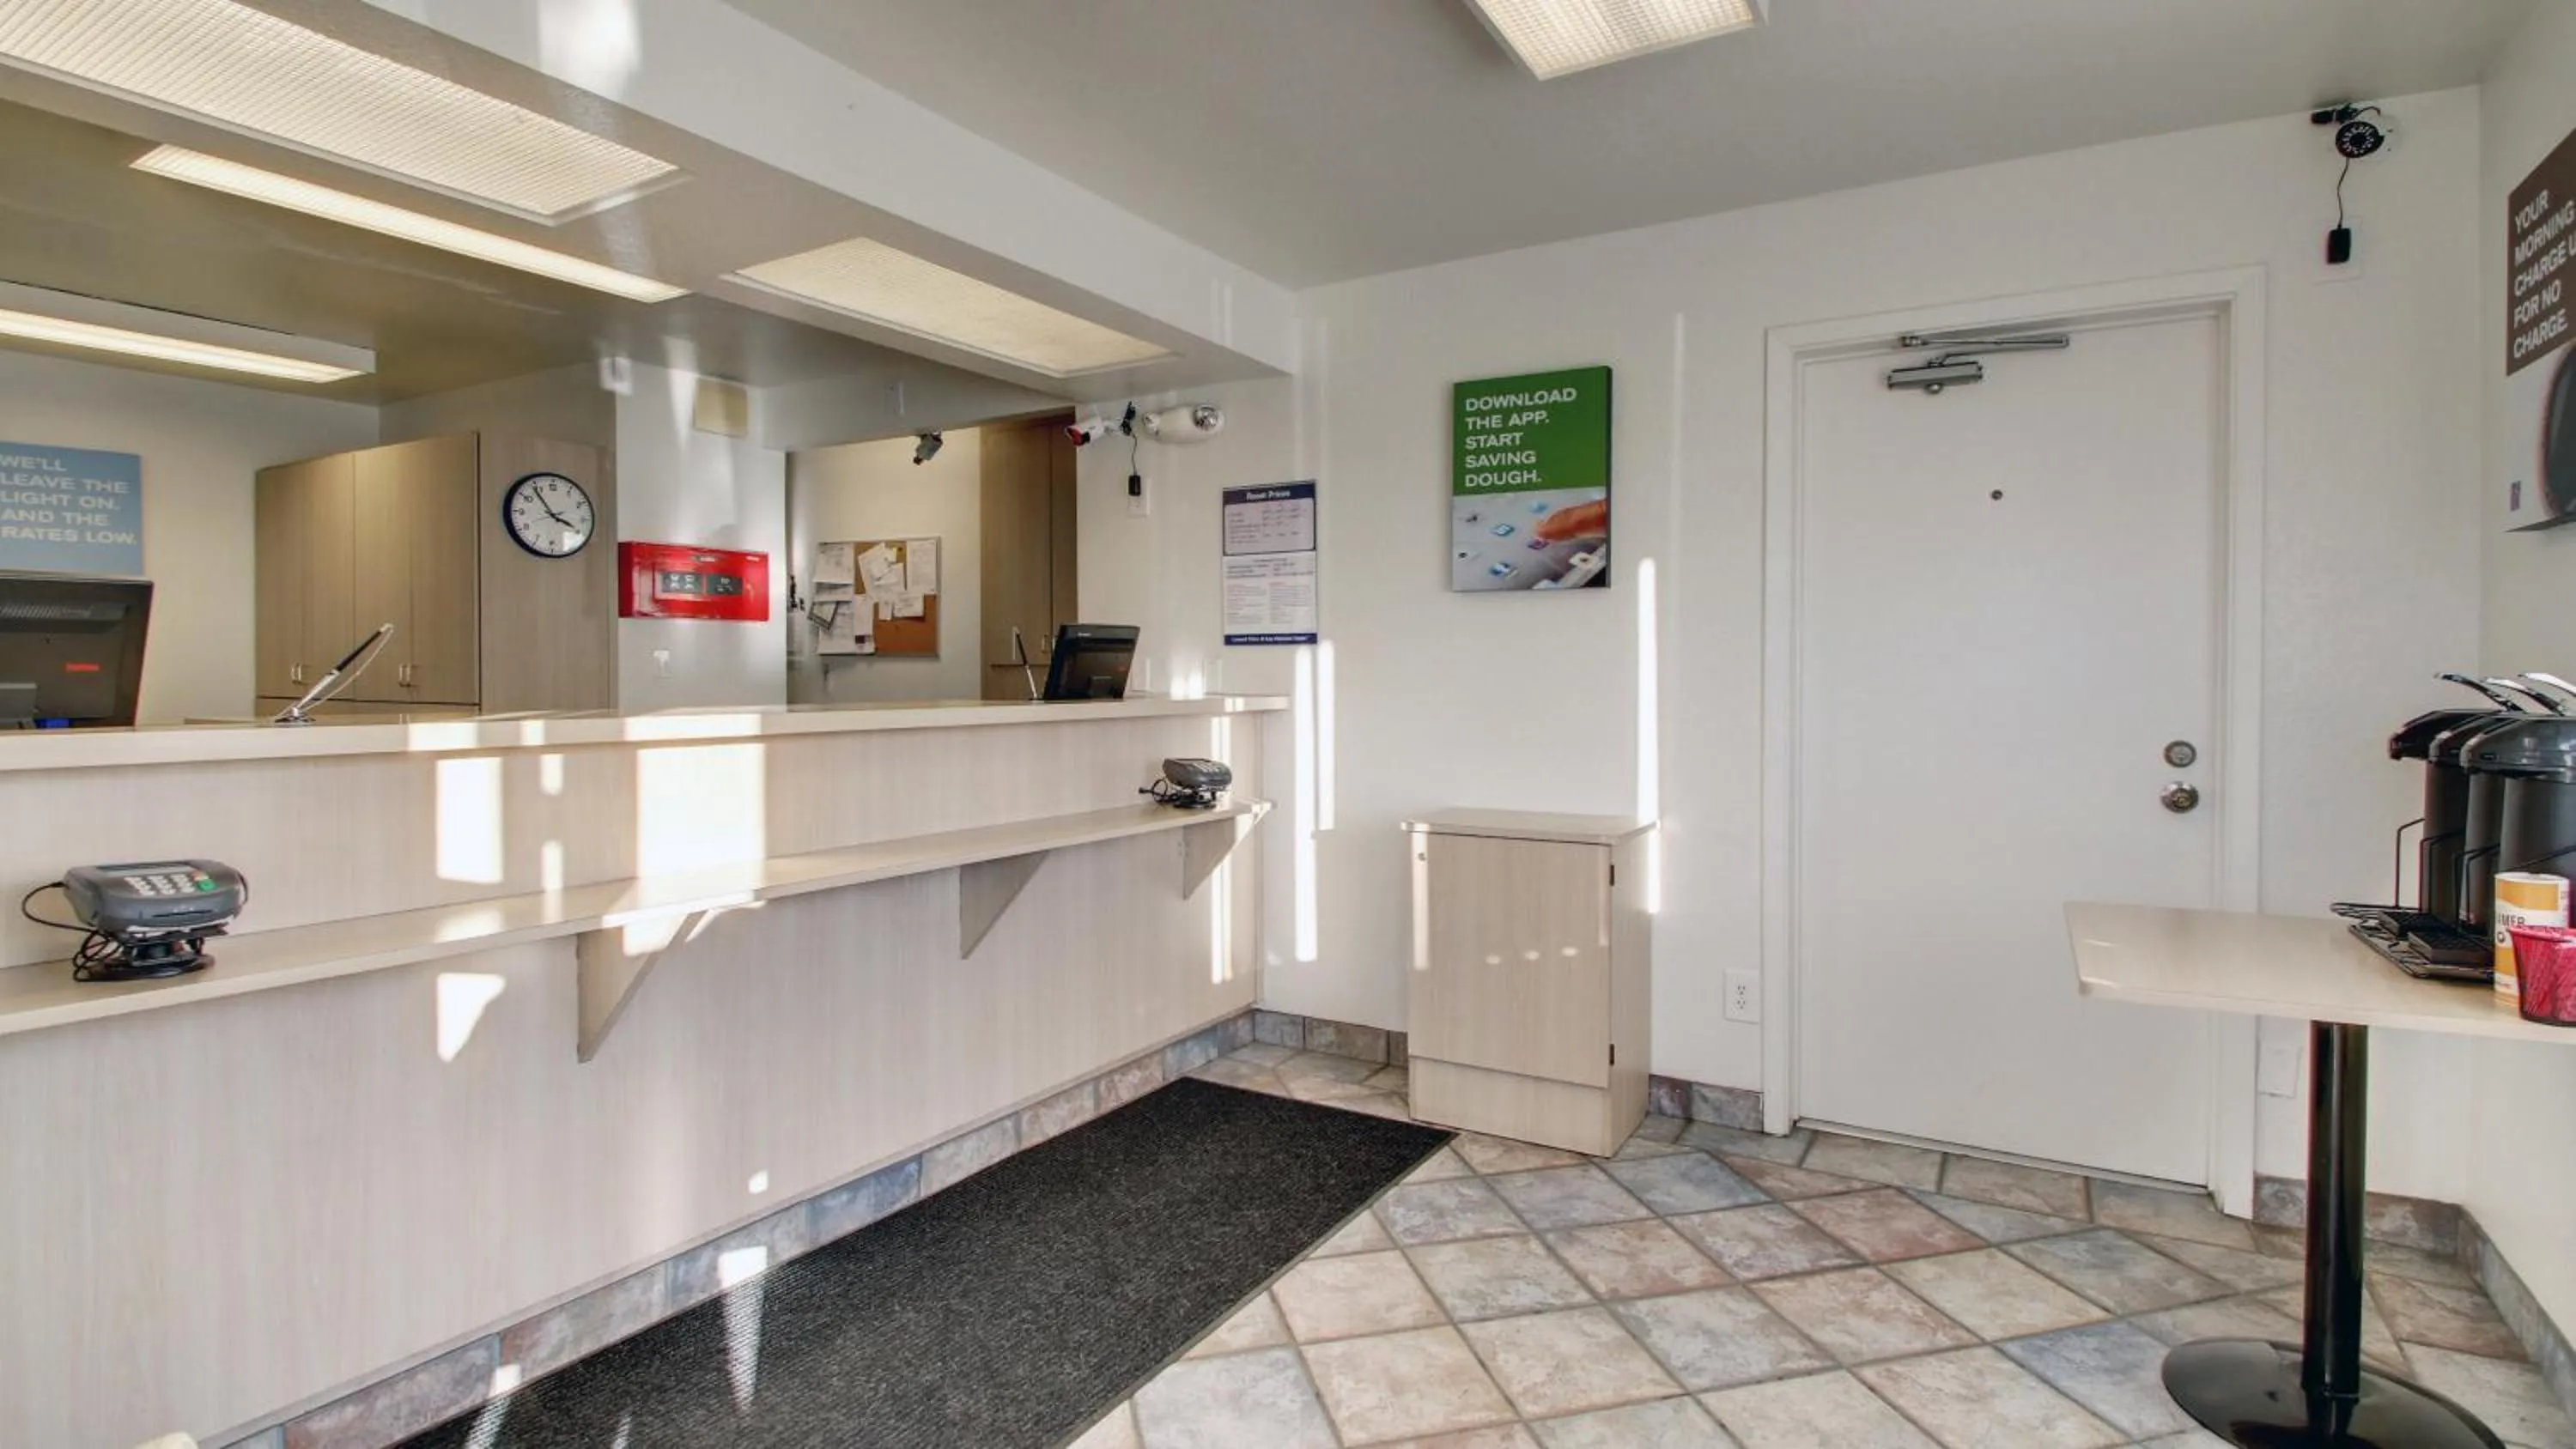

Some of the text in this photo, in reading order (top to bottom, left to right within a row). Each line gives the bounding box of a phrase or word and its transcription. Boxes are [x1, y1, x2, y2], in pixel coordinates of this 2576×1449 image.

[2515, 189, 2549, 233] YOUR
[2514, 200, 2574, 268] MORNING
[2514, 240, 2567, 297] CHARGE
[2513, 279, 2561, 330] FOR NO
[1465, 388, 1577, 411] DOWNLOAD
[1465, 410, 1549, 431] THE APP.
[1466, 433, 1523, 450] START
[0, 454, 67, 471] WE'LL
[1466, 451, 1536, 468] SAVING
[0, 473, 131, 494] LEAVE THE
[1465, 470, 1542, 487] DOUGH.
[0, 491, 71, 506] LIGHT
[1, 508, 110, 526] AND THE
[0, 526, 137, 545] RATES LOW.
